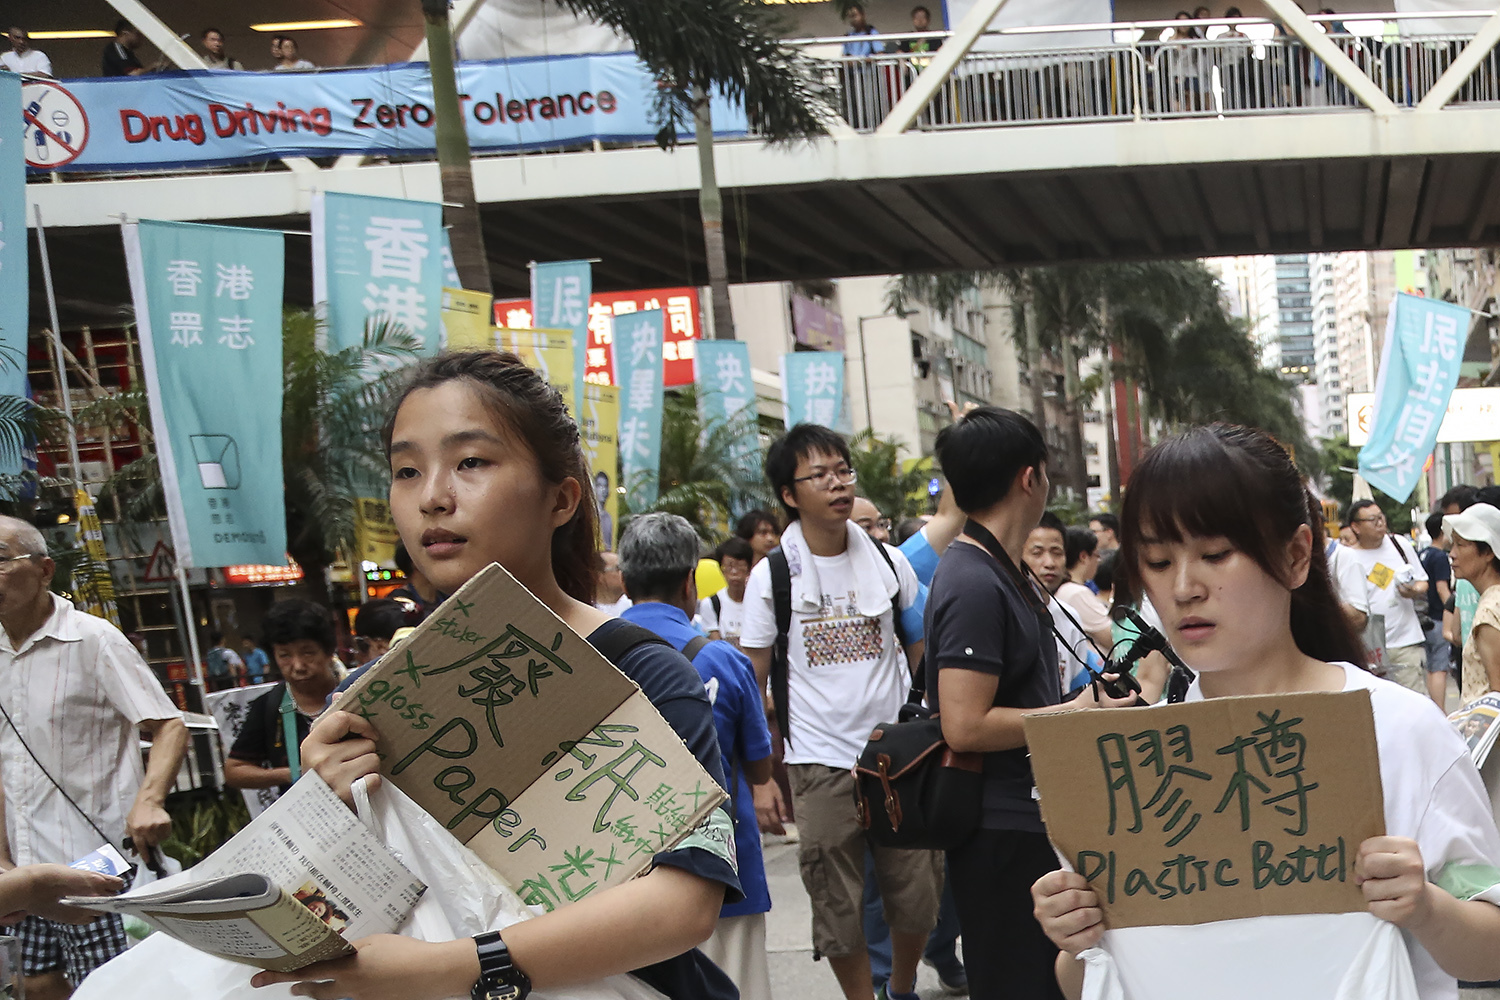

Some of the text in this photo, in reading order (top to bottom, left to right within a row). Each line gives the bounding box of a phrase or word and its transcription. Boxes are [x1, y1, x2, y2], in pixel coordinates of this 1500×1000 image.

[119, 108, 207, 145] Drug
[208, 102, 333, 137] Driving
[350, 97, 435, 129] Zero
[167, 260, 255, 301] 香港
[169, 311, 256, 350] 眾志
[430, 617, 488, 646] sticker
[358, 679, 437, 731] gloss
[391, 716, 548, 853] Paper
[1096, 708, 1319, 848] 膠樽
[1077, 836, 1357, 905] Plastic Bottl
